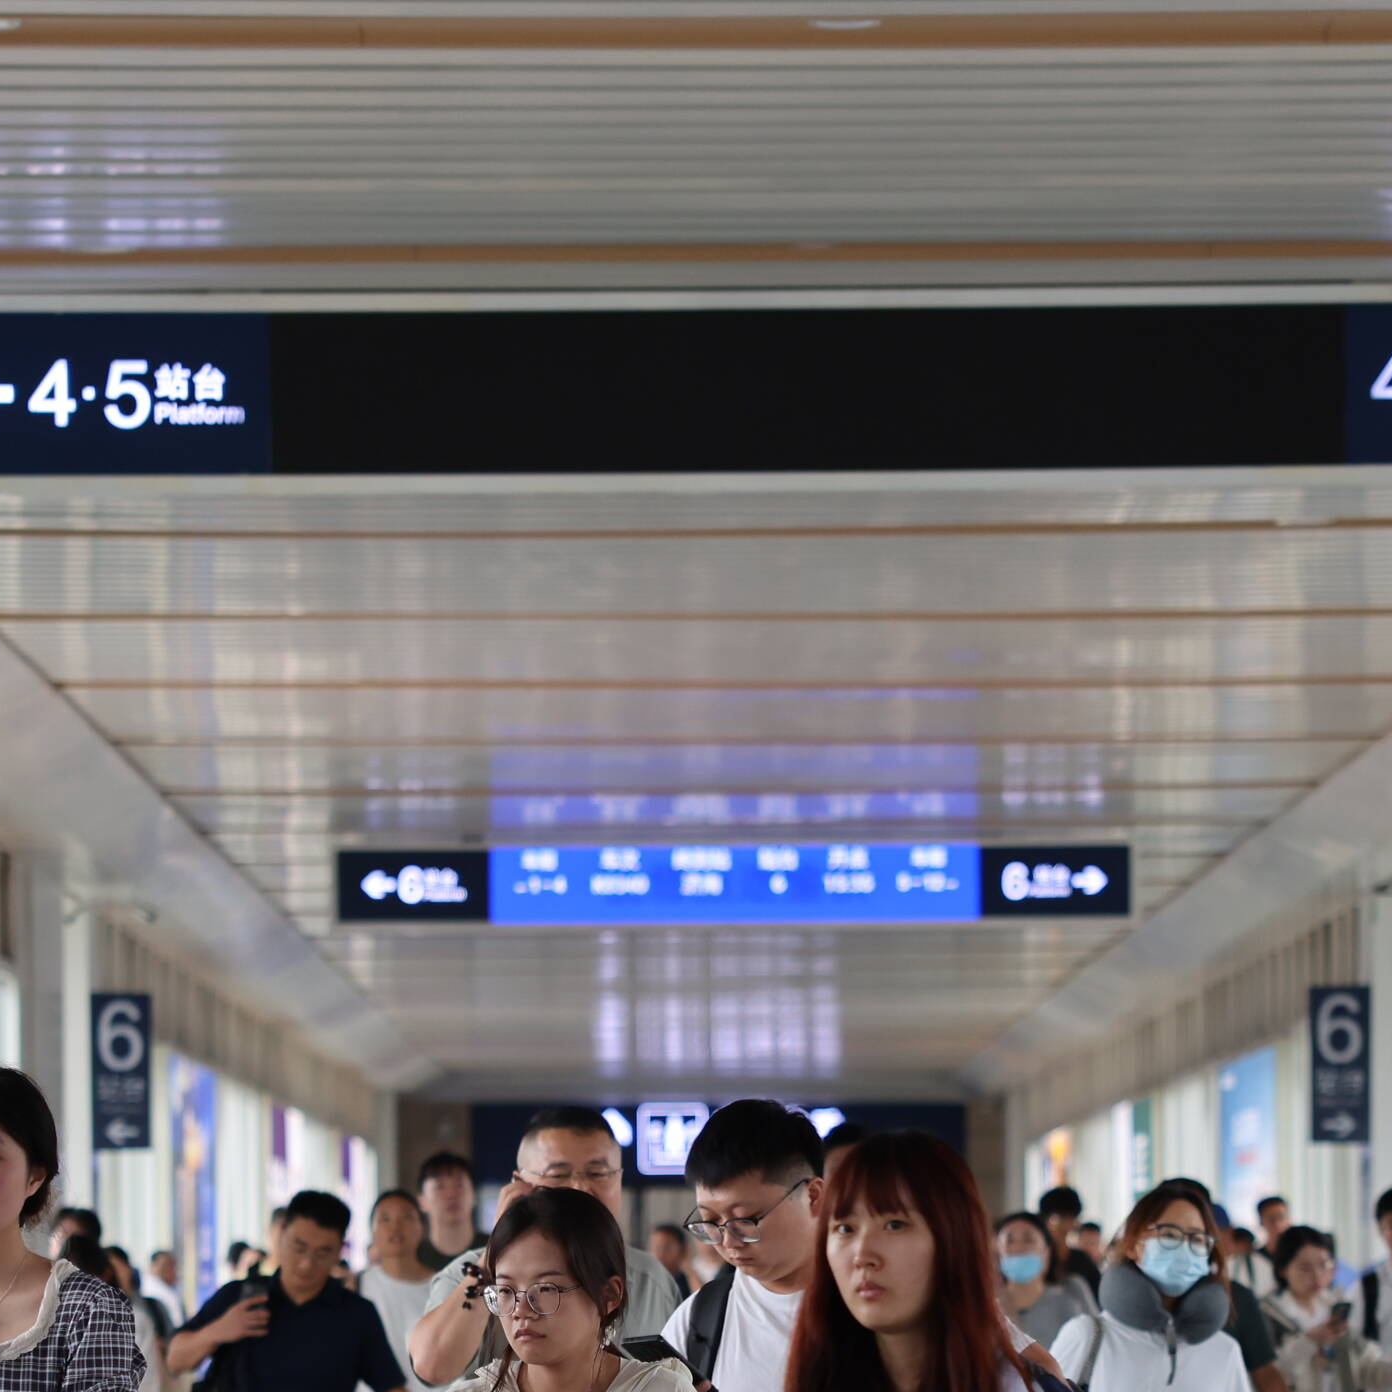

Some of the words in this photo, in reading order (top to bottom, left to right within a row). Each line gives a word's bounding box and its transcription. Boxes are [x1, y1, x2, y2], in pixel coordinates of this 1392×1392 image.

[153, 362, 226, 401] 站台
[153, 402, 246, 425] Platform
[1001, 861, 1030, 901] 6
[97, 1000, 144, 1072] 6
[1317, 993, 1364, 1064] 6
